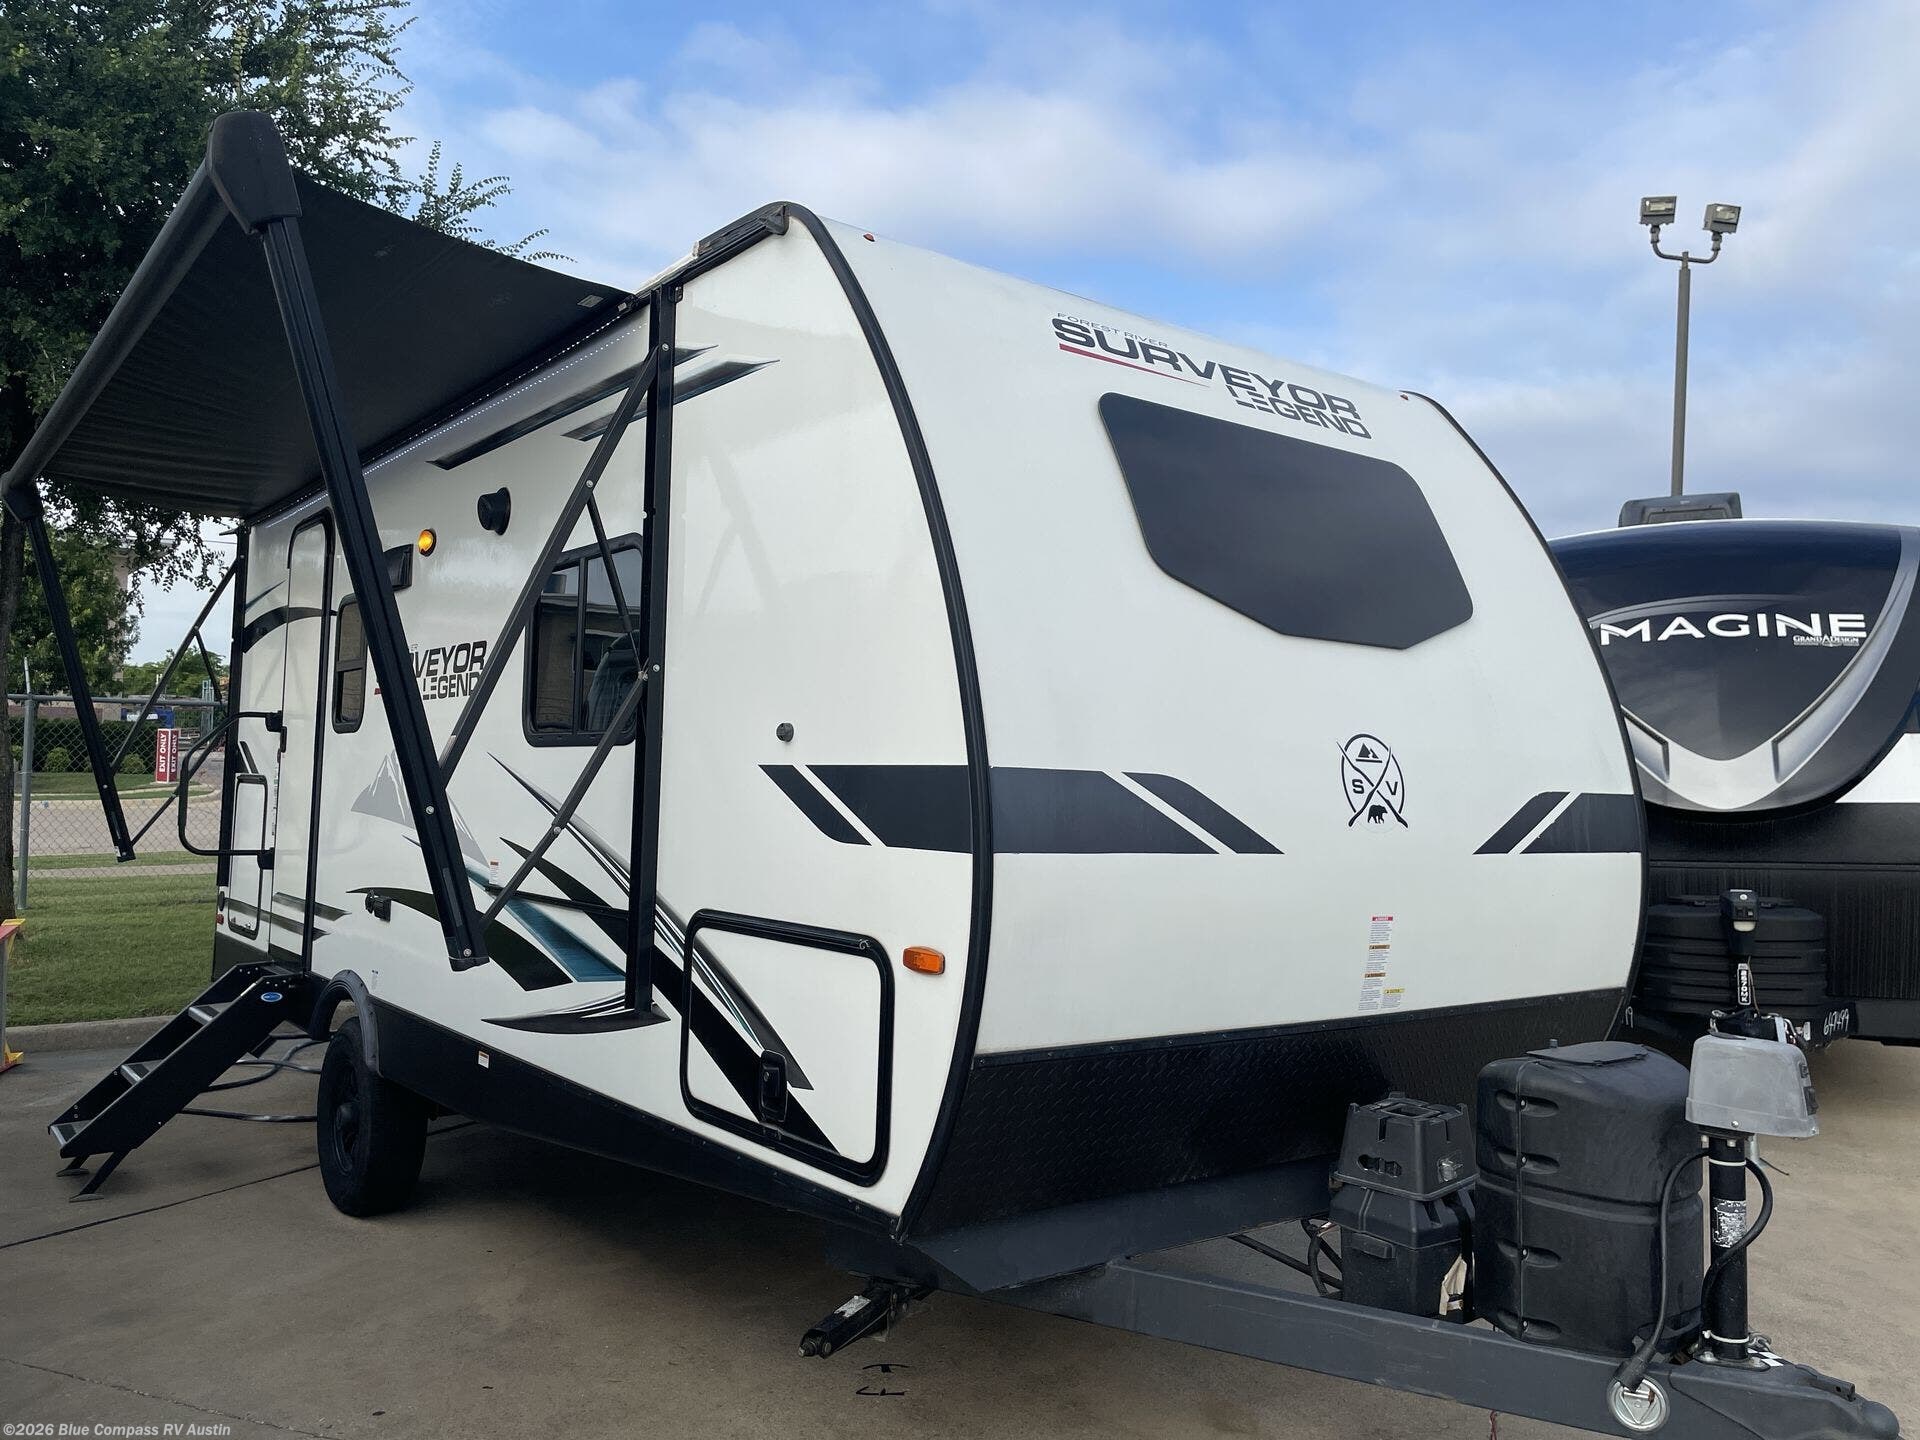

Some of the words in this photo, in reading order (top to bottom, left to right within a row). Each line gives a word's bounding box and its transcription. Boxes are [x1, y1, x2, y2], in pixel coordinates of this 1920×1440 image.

[1057, 313, 1120, 335] FOREST
[1124, 331, 1168, 348] RIVER
[1052, 317, 1361, 420] SURVEYOR
[1226, 385, 1372, 439] LEGEND
[423, 672, 480, 700] LEGEND
[1352, 778, 1365, 794] S
[1385, 780, 1398, 796] V
